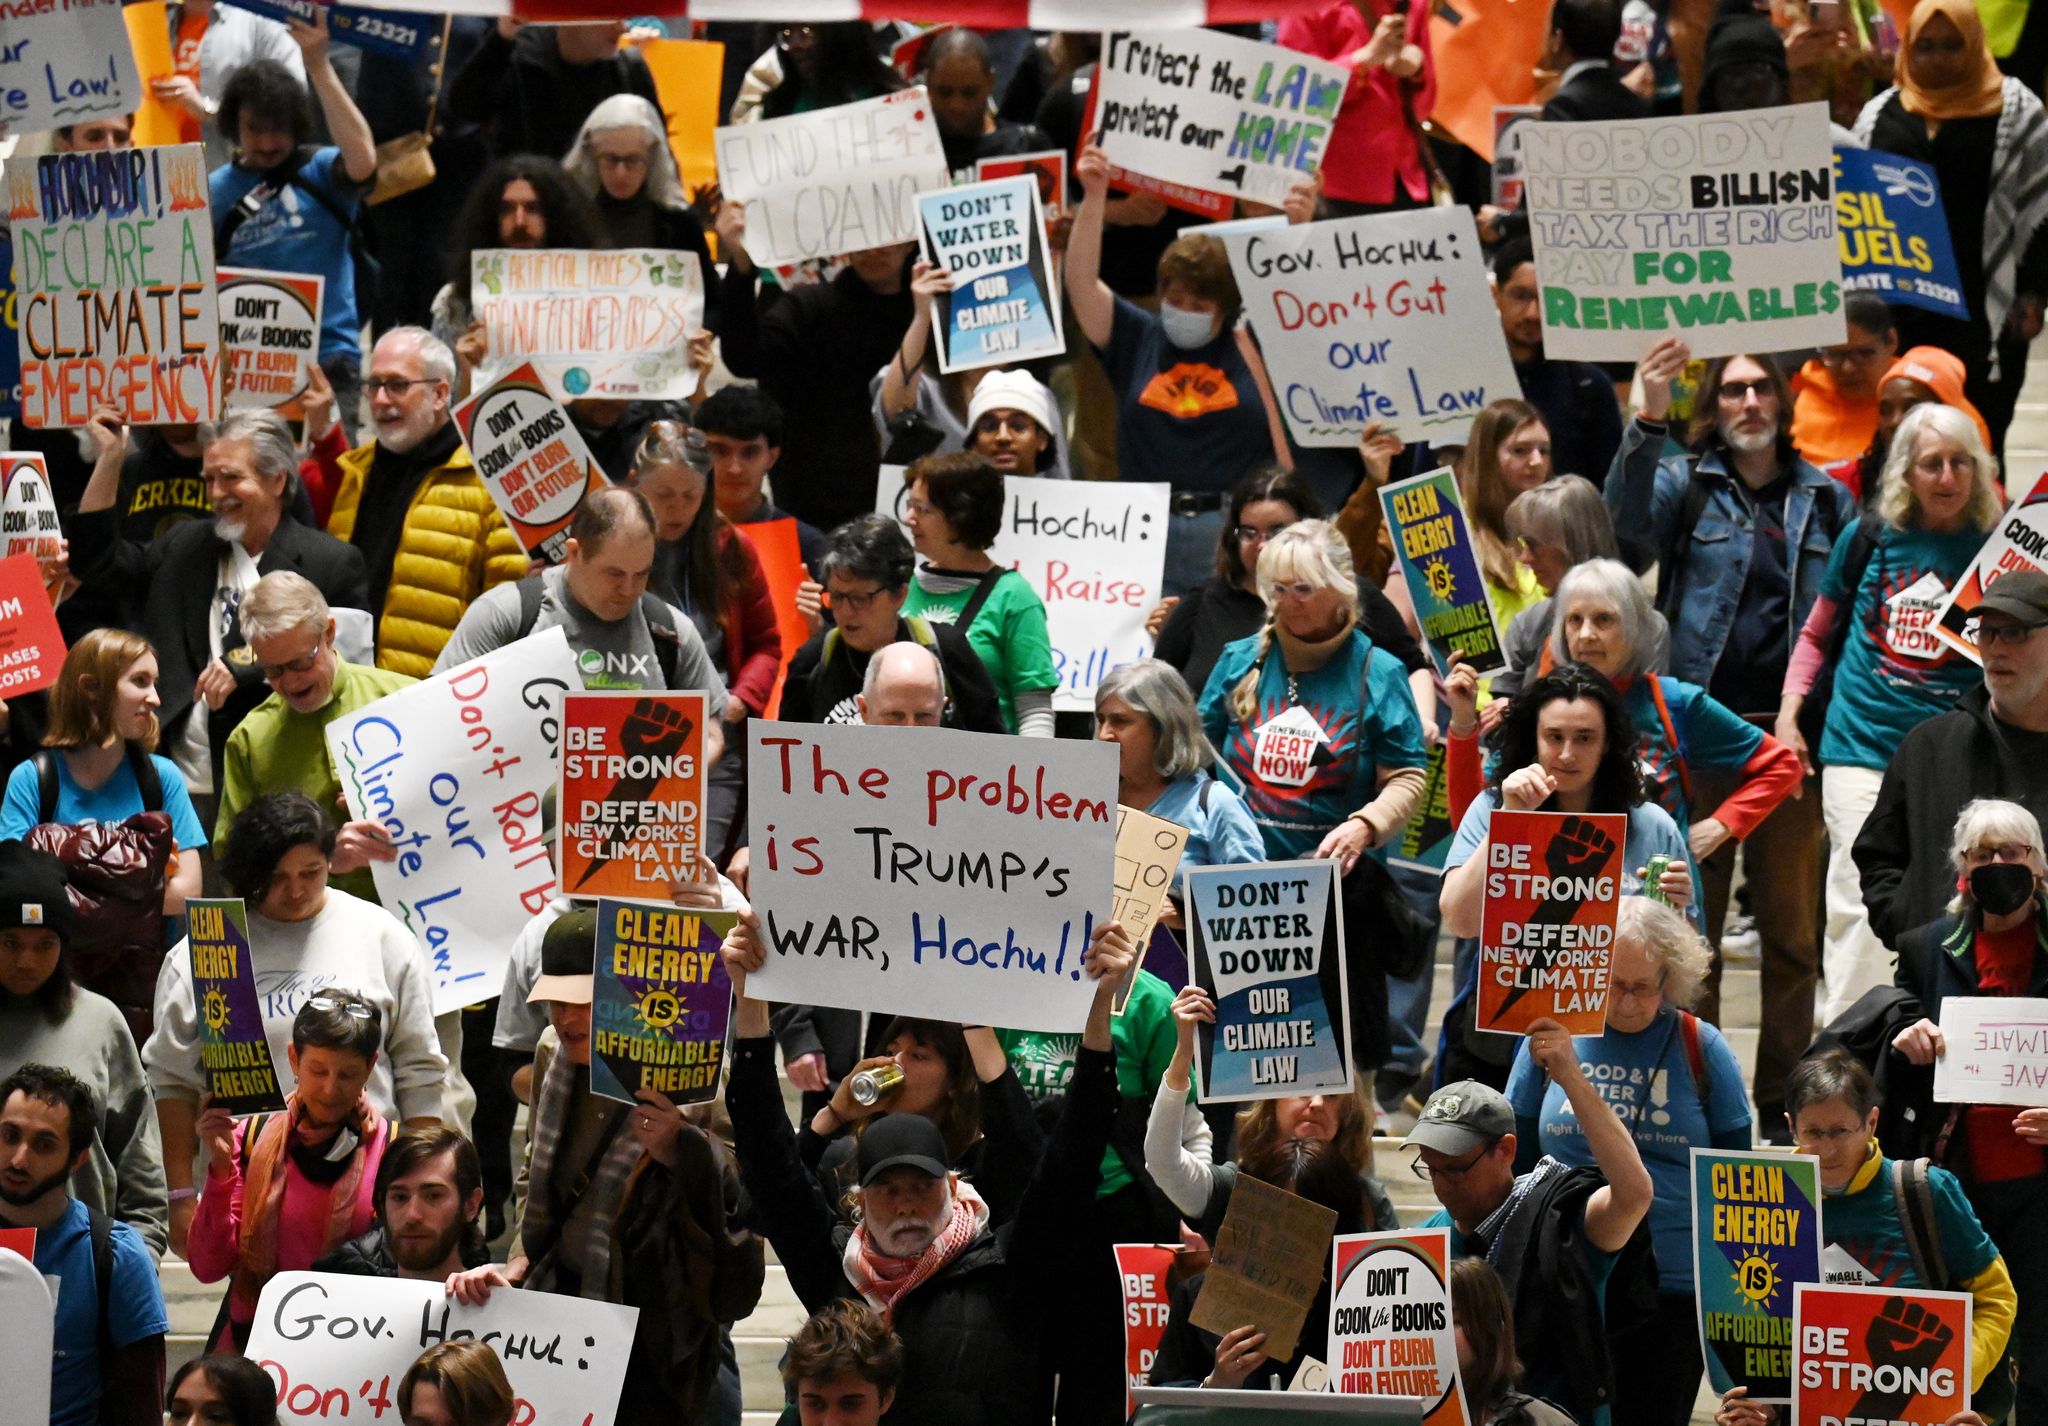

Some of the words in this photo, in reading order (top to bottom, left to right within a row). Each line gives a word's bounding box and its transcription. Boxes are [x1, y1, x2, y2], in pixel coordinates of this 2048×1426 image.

[356, 15, 418, 46] 23321
[45, 54, 121, 103] Law!
[1210, 60, 1246, 100] the
[1252, 62, 1342, 121] LAW
[722, 121, 818, 196] FUND
[823, 107, 894, 169] THE
[1096, 98, 1179, 147] protect
[1181, 122, 1225, 149] our
[1227, 111, 1327, 175] HOME
[1521, 115, 1795, 175] NOBODY
[941, 193, 1014, 222] DON'T
[1529, 173, 1681, 212] NEEDS
[937, 218, 1019, 248] WATER
[1534, 211, 1628, 250] TAX
[1634, 210, 1731, 249] THE
[1737, 204, 1834, 246] RICH
[19, 220, 162, 294] DECLARE
[181, 216, 202, 283] A
[949, 243, 1023, 272] DOWN
[1246, 236, 1321, 279] Gov.
[1838, 229, 1934, 274] UELS
[1538, 249, 1626, 286] PAY
[1633, 249, 1735, 286] FOR
[973, 275, 1009, 300] OUR
[1272, 284, 1377, 331] Don't
[1386, 275, 1447, 318] Gut
[26, 283, 208, 360] CLIMATE
[235, 297, 281, 320] DON'T
[956, 299, 1032, 330] CLIMATE
[261, 328, 312, 348] BOOKS
[981, 328, 1020, 353] LAW
[256, 351, 297, 373] BURN
[20, 352, 220, 427] EMERGENCY
[240, 373, 296, 394] FUTURE
[1286, 382, 1399, 426] Climate
[1407, 367, 1486, 418] Law
[485, 400, 525, 438] DON'T
[478, 443, 512, 479] COOK
[520, 408, 567, 450] BOOKS
[499, 458, 534, 498] DON'T
[532, 437, 572, 474] BURN
[510, 481, 538, 518] OUR
[533, 457, 586, 501] FUTURE
[1012, 494, 1152, 543] Hochul:
[1392, 483, 1441, 525] CLEAN
[3, 510, 28, 533] COOK
[1401, 514, 1457, 561] ENERGY
[2003, 518, 2048, 560] COOK
[1045, 560, 1147, 608] Raise
[1432, 571, 1448, 592] IS
[1447, 625, 1496, 659] ENERGY
[1892, 627, 1940, 652] NOW
[566, 726, 607, 751] BE
[1262, 733, 1315, 758] HEAT
[1267, 724, 1318, 739] RENEWABLE
[447, 665, 522, 779] Don't
[492, 790, 548, 870] Roll
[565, 754, 695, 780] STRONG
[760, 737, 890, 800] The
[926, 763, 1110, 827] problem
[1259, 755, 1308, 781] NOW
[580, 800, 698, 823] DEFEND
[564, 822, 614, 840] NEW
[620, 823, 696, 842] YORK'S
[351, 715, 432, 879] Climate
[413, 886, 486, 988] Law!
[576, 840, 697, 865] CLIMATE
[765, 824, 825, 876] is
[1489, 843, 1532, 870] BE
[634, 863, 697, 883] LAW
[1487, 873, 1614, 902] STRONG
[1216, 879, 1309, 909] DON'T
[189, 906, 225, 941] CLEAN
[615, 906, 701, 949] CLEAN
[1206, 913, 1313, 943] WATER
[1501, 921, 1613, 948] DEFEND
[767, 909, 891, 972] WAR,
[911, 910, 1094, 982] Hochul!
[1219, 946, 1315, 976] DOWN
[1483, 944, 1537, 967] NEW
[1541, 949, 1610, 968] YORK'S
[192, 945, 238, 979] ENERGY
[612, 942, 716, 984] ENERGY
[1495, 966, 1608, 990] CLIMATE
[208, 999, 221, 1016] IS
[647, 997, 674, 1021] IS
[1247, 987, 1290, 1016] OUR
[1553, 991, 1606, 1014] LAW
[595, 1029, 721, 1067] AFFORDABLE
[1222, 1019, 1316, 1053] CLIMATE
[212, 1068, 275, 1098] ENERGY
[640, 1063, 720, 1093] ENERGY
[1250, 1054, 1299, 1085] LAW
[1580, 1062, 1627, 1081] OOD
[1629, 1067, 1644, 1084] &
[2000, 1064, 2048, 1089] AVE
[1546, 1122, 1573, 1137] fight
[1655, 1131, 1689, 1144] here.
[1711, 1162, 1785, 1204] CLEAN
[1713, 1204, 1800, 1247] ENERGY
[1124, 1273, 1156, 1299] BE
[1366, 1267, 1410, 1298] DON'T
[1745, 1265, 1768, 1291] IS
[273, 1281, 394, 1340] Gov.
[1127, 1302, 1170, 1328] STR
[1334, 1306, 1372, 1336] COOK
[1372, 1309, 1391, 1330] the
[1392, 1302, 1447, 1333] BOOKS
[1706, 1311, 1792, 1346] AFFORDAB
[1802, 1325, 1850, 1357] BE
[1342, 1340, 1387, 1370] DON'T
[1389, 1337, 1437, 1367] BURN
[1745, 1347, 1791, 1378] ENER
[1340, 1373, 1373, 1394] OUR
[1375, 1368, 1443, 1397] FUTURE
[1801, 1360, 1955, 1398] STRONG
